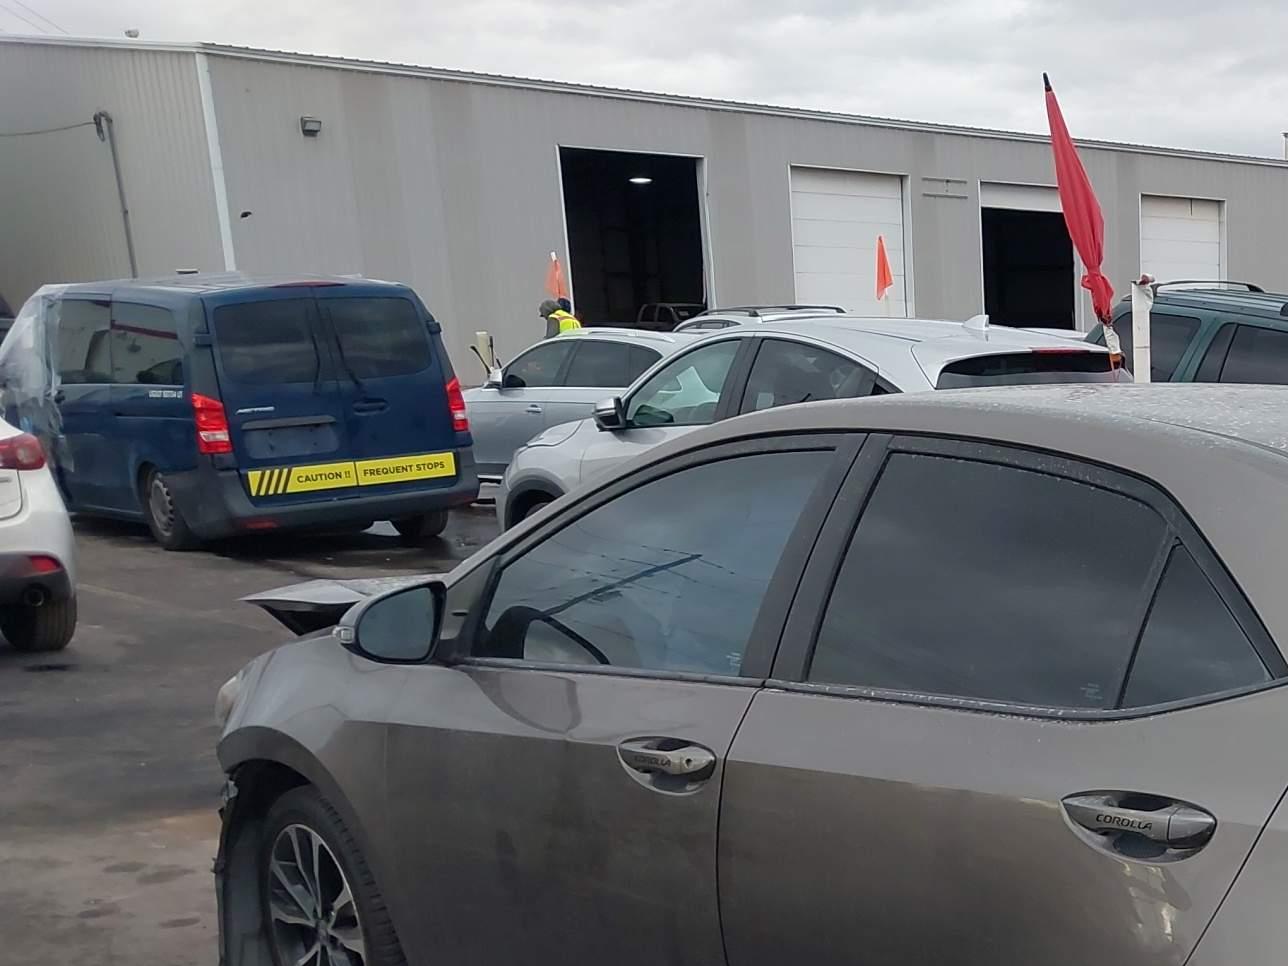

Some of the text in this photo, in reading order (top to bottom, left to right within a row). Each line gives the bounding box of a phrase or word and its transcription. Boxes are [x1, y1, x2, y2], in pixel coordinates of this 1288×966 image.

[296, 472, 342, 484] CAUTION
[363, 464, 414, 477] FREQUENT
[415, 461, 445, 472] STOPS
[1095, 814, 1153, 831] COROLLA
